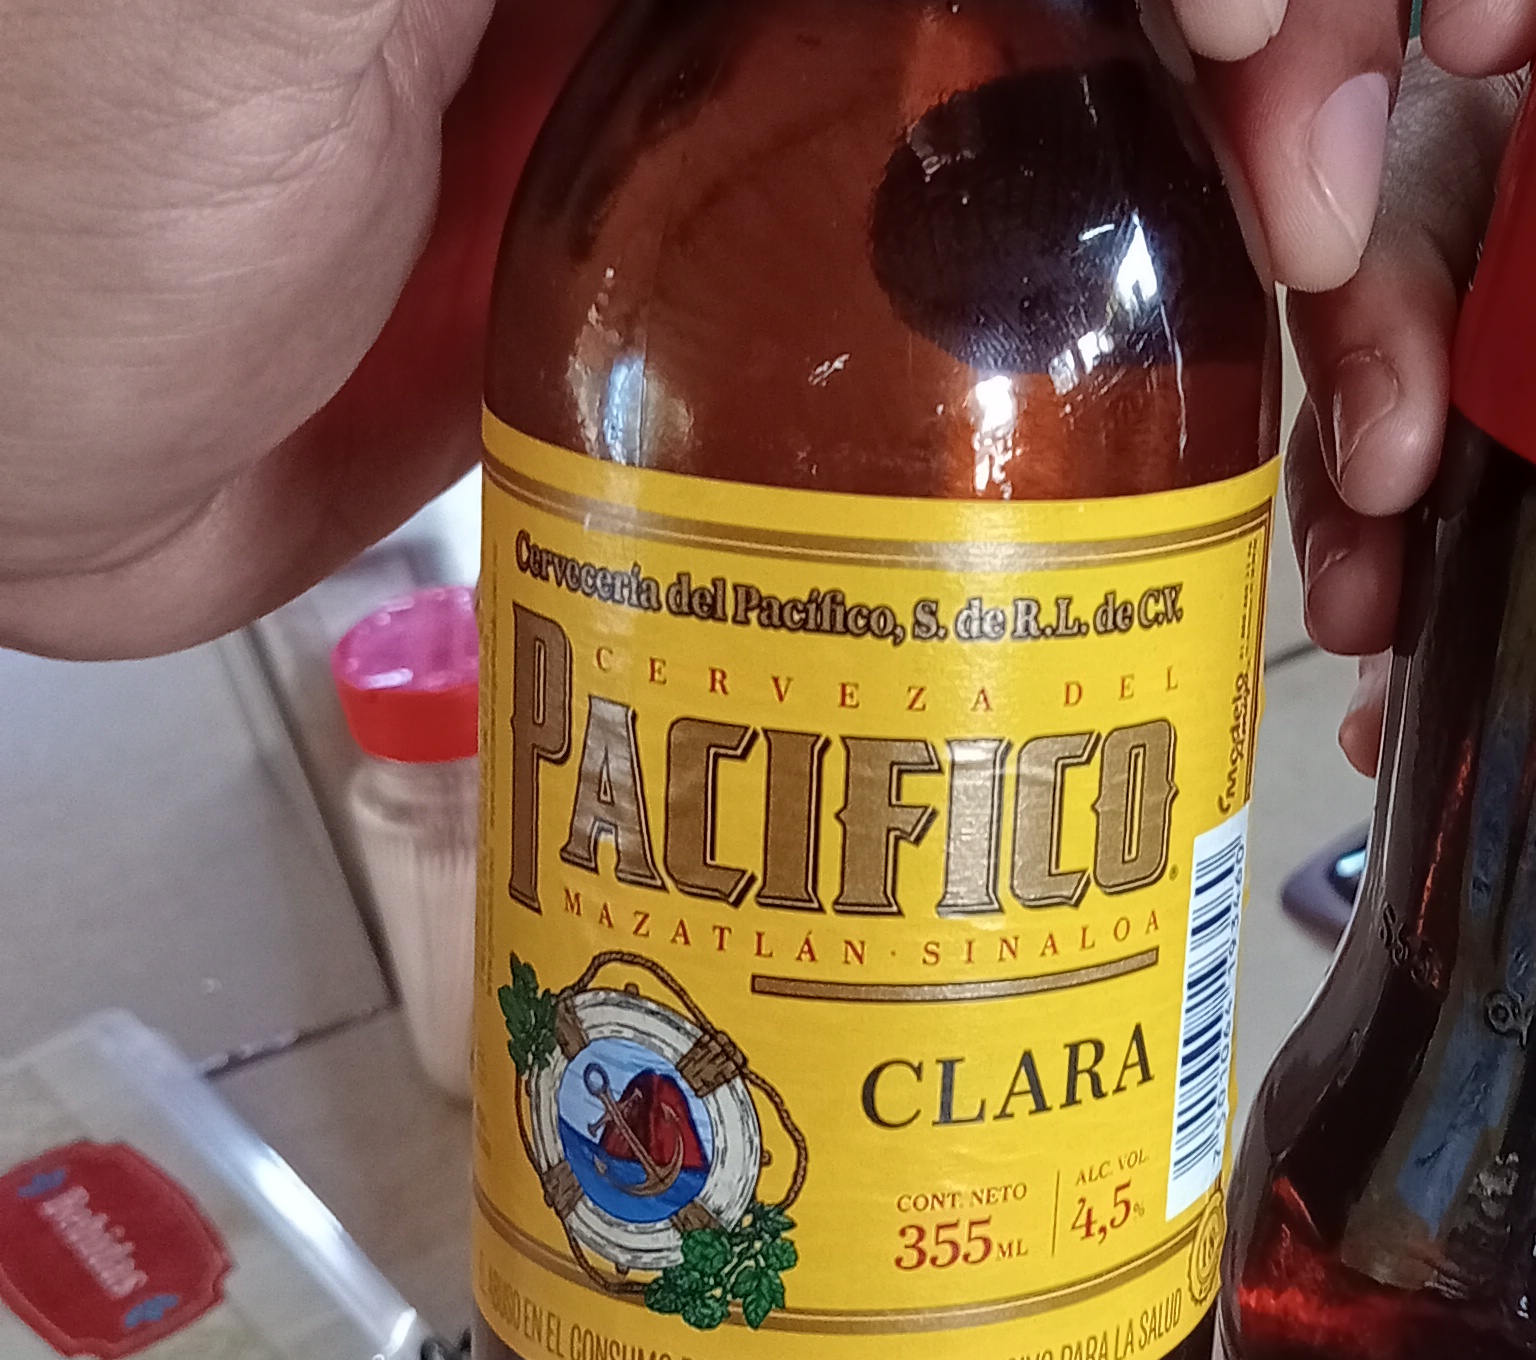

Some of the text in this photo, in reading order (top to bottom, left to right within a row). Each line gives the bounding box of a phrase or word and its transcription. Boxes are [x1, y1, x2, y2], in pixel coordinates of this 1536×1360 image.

[515, 529, 662, 612] Cervecería
[666, 572, 728, 623] del
[732, 581, 905, 646] Pacífico,
[912, 599, 948, 639] S.
[955, 596, 1006, 642] de
[1094, 591, 1134, 635] de
[596, 646, 1179, 713] CERVEZA DEL
[510, 601, 1180, 918] PACIFICO
[922, 908, 1161, 965] SINALOA
[860, 1021, 1156, 1129] CLARA
[896, 1181, 1028, 1213] CONT. NETO
[523, 1296, 543, 1344] EN
[546, 1310, 565, 1358] EL
[1138, 1287, 1182, 1351] SALUD
